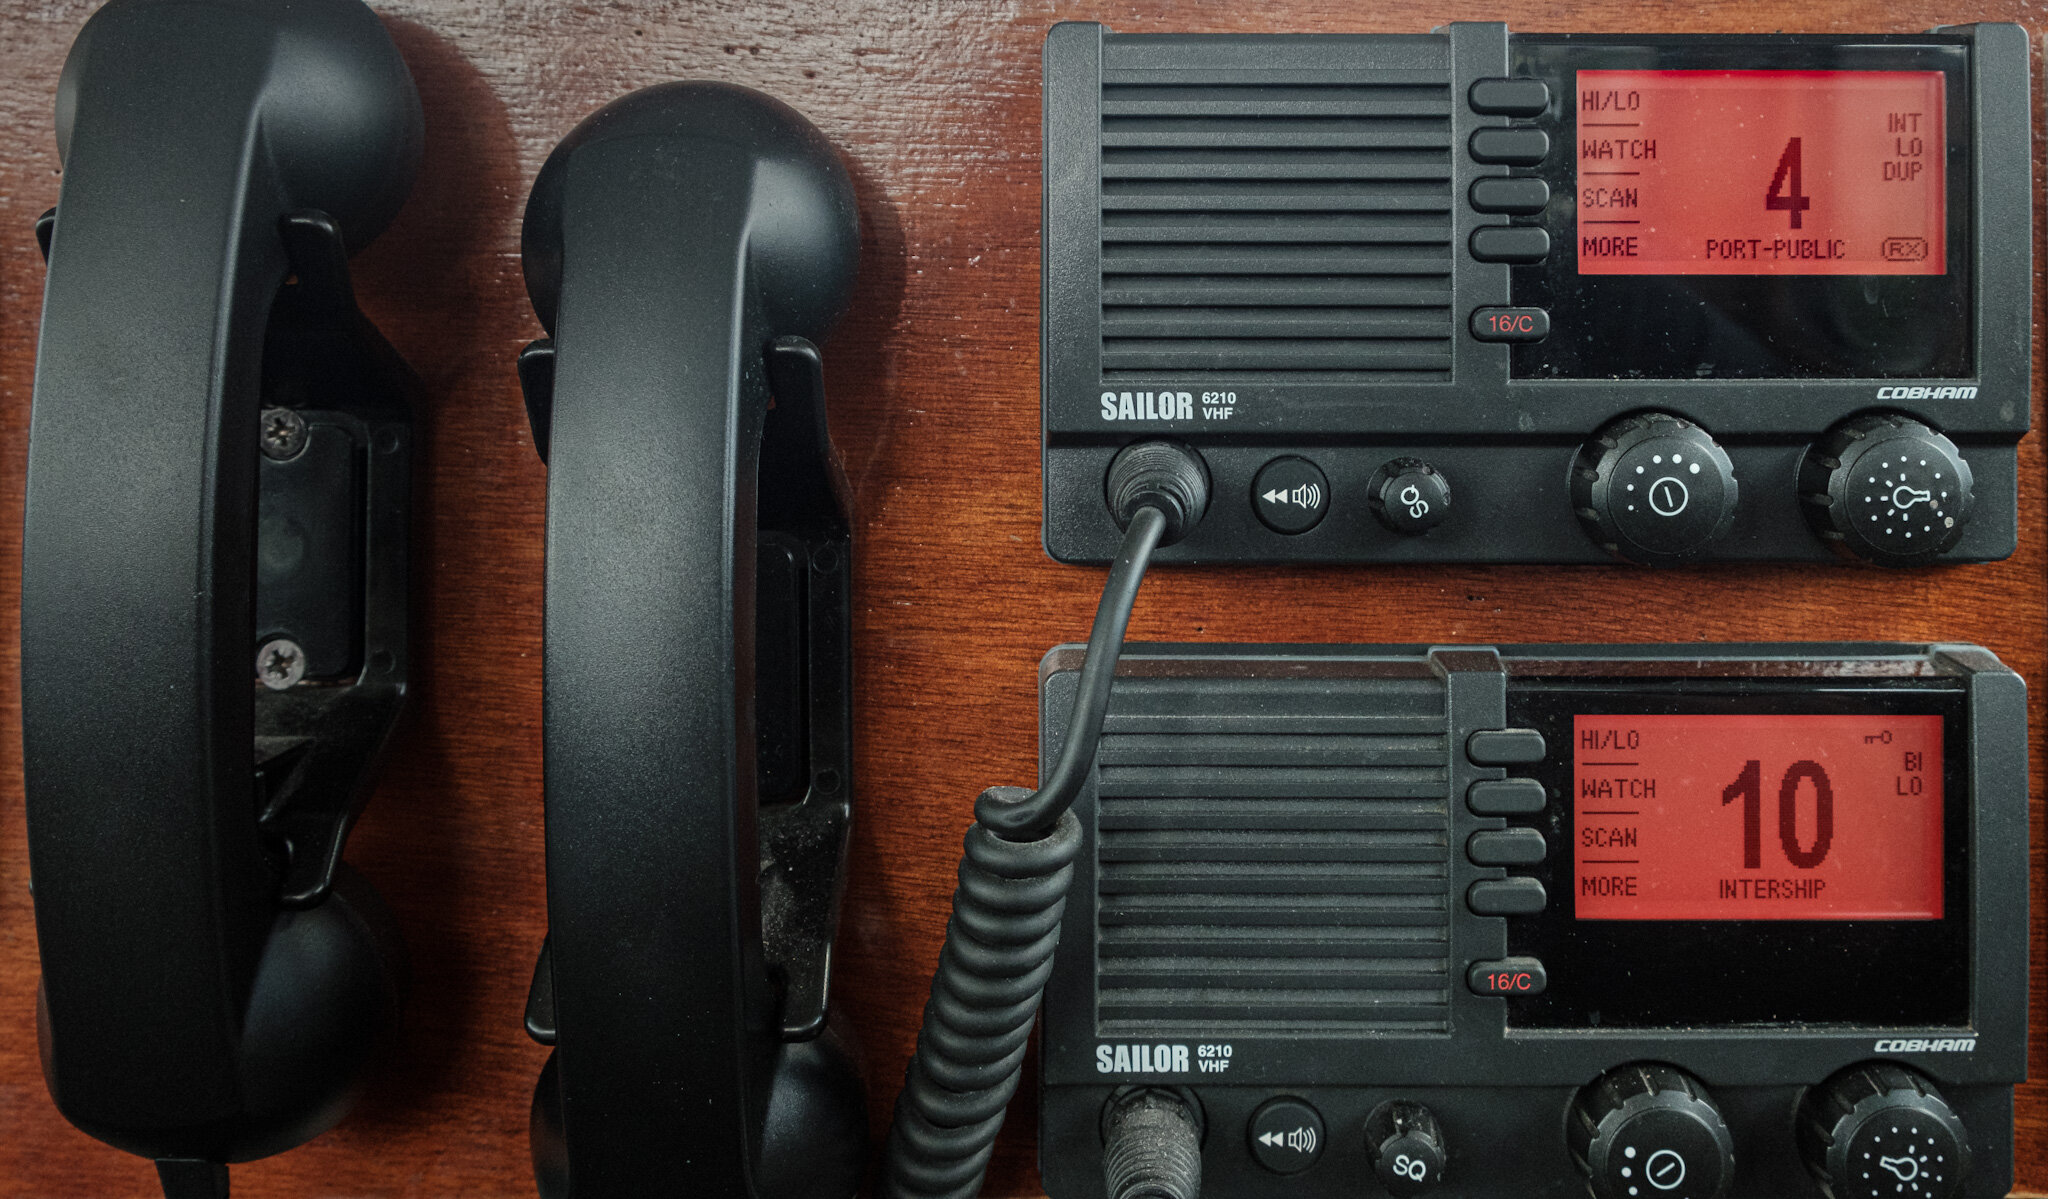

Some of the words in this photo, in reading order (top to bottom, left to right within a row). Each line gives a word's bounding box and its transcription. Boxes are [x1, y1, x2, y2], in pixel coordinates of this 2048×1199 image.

[1582, 91, 1640, 112] HI/LO
[1888, 113, 1923, 134] INT
[1582, 139, 1657, 160] WATCH
[1896, 137, 1923, 158] LO
[1883, 162, 1923, 182] DUP
[1765, 136, 1810, 230] 4
[1582, 188, 1638, 209] SCAN
[1582, 237, 1638, 258] MORE
[1706, 239, 1846, 260] PORT-PUBLIC
[1489, 314, 1533, 334] 16/C
[1202, 392, 1236, 405] 6210
[1876, 386, 1979, 400] COBHAM
[1101, 391, 1193, 420] SAILOR
[1202, 407, 1234, 420] VHF
[1581, 729, 1640, 751] HI/LO
[1904, 751, 1923, 772] BI
[1581, 778, 1656, 800] WATCH
[1896, 776, 1923, 797] LO
[1721, 759, 1834, 870] 10
[1581, 827, 1637, 848] SCAN
[1581, 876, 1638, 897] MORE
[1719, 879, 1826, 900] INTERSHIP
[1487, 972, 1531, 992] 16/C
[1198, 1045, 1233, 1058] 6210
[1874, 1038, 1976, 1053] COBHAM
[1096, 1044, 1189, 1073] SAILOR
[1198, 1060, 1230, 1073] VHF
[1393, 1154, 1426, 1182] SQ
